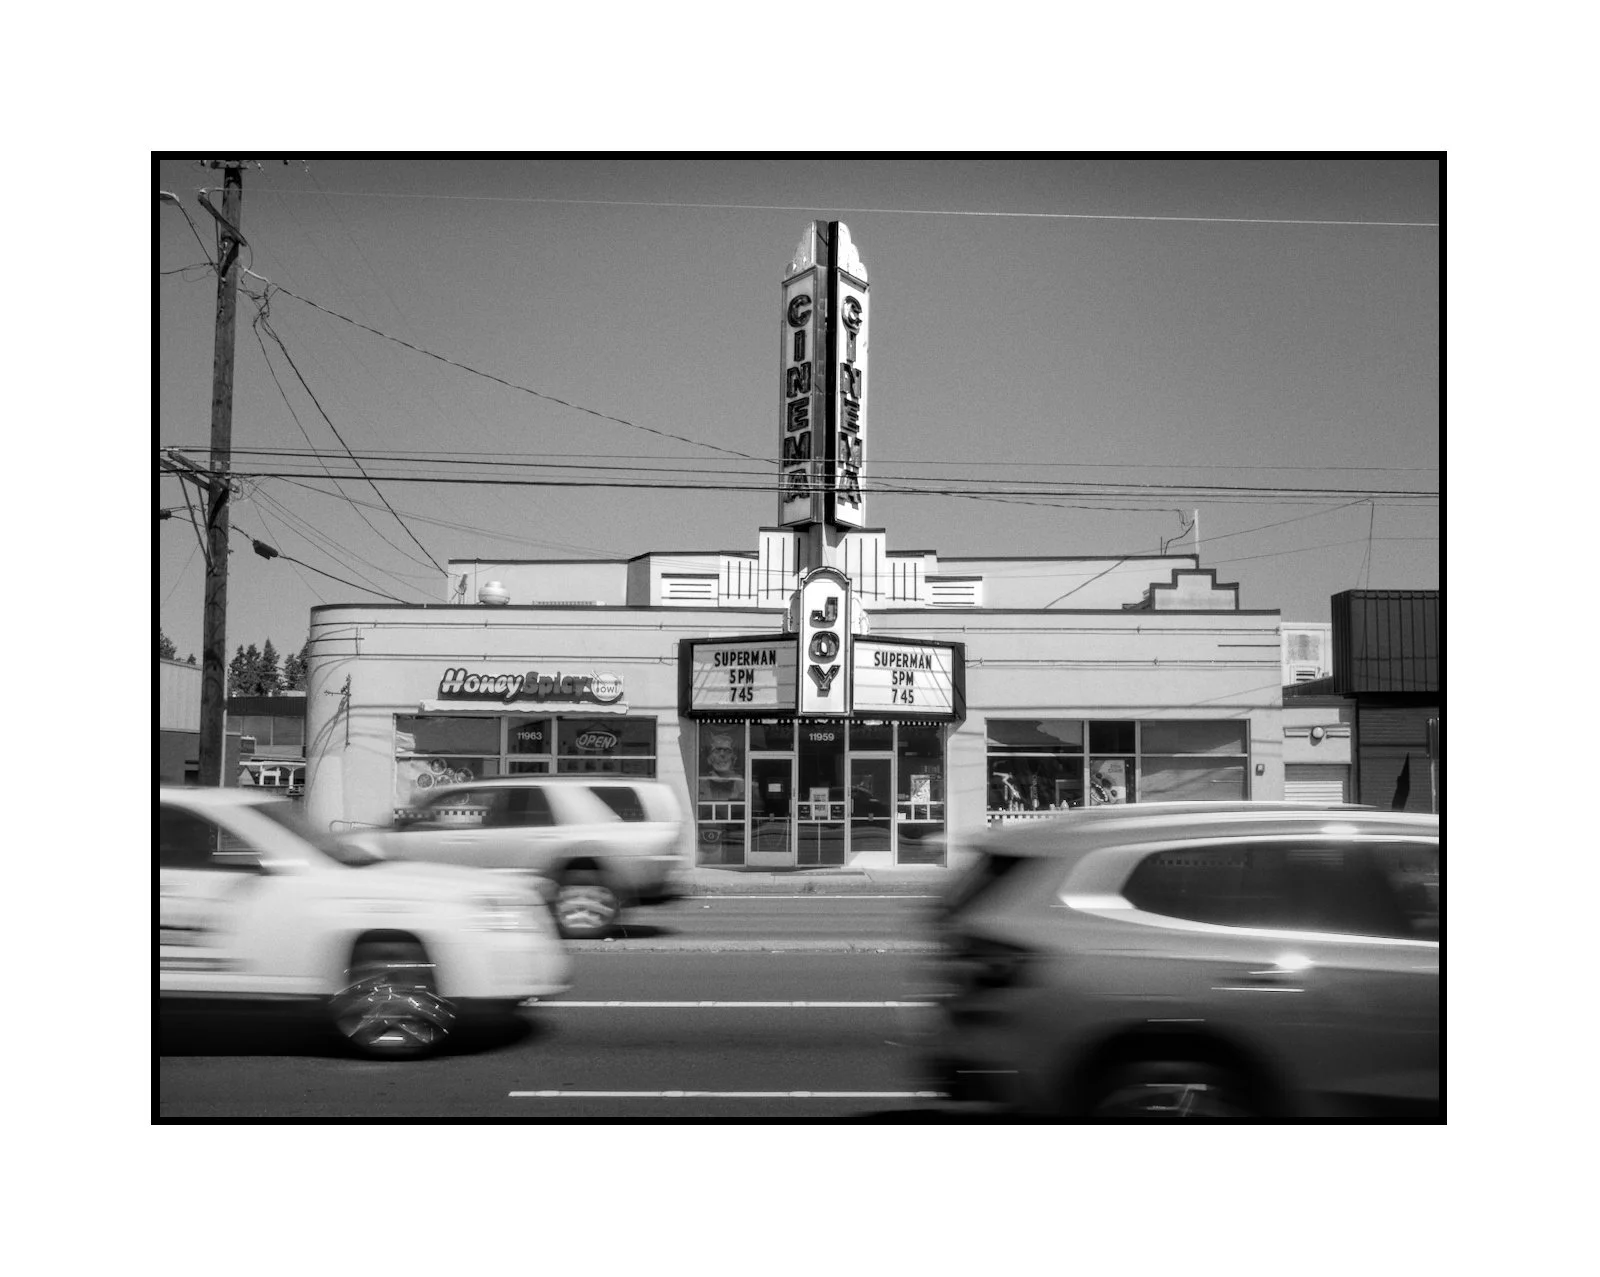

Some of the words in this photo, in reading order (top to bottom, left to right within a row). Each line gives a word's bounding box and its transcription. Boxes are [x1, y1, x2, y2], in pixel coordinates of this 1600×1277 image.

[784, 294, 812, 503] CINEMA
[837, 295, 863, 510] CINEMA
[807, 597, 841, 697] JOY
[714, 650, 776, 667] SUPERMAN
[874, 651, 932, 669] SUPERMAN
[440, 667, 524, 704] Honey
[523, 671, 591, 703] Spicy
[516, 732, 542, 740] 11963
[578, 734, 613, 749] OPEN
[809, 732, 835, 742] 11959
